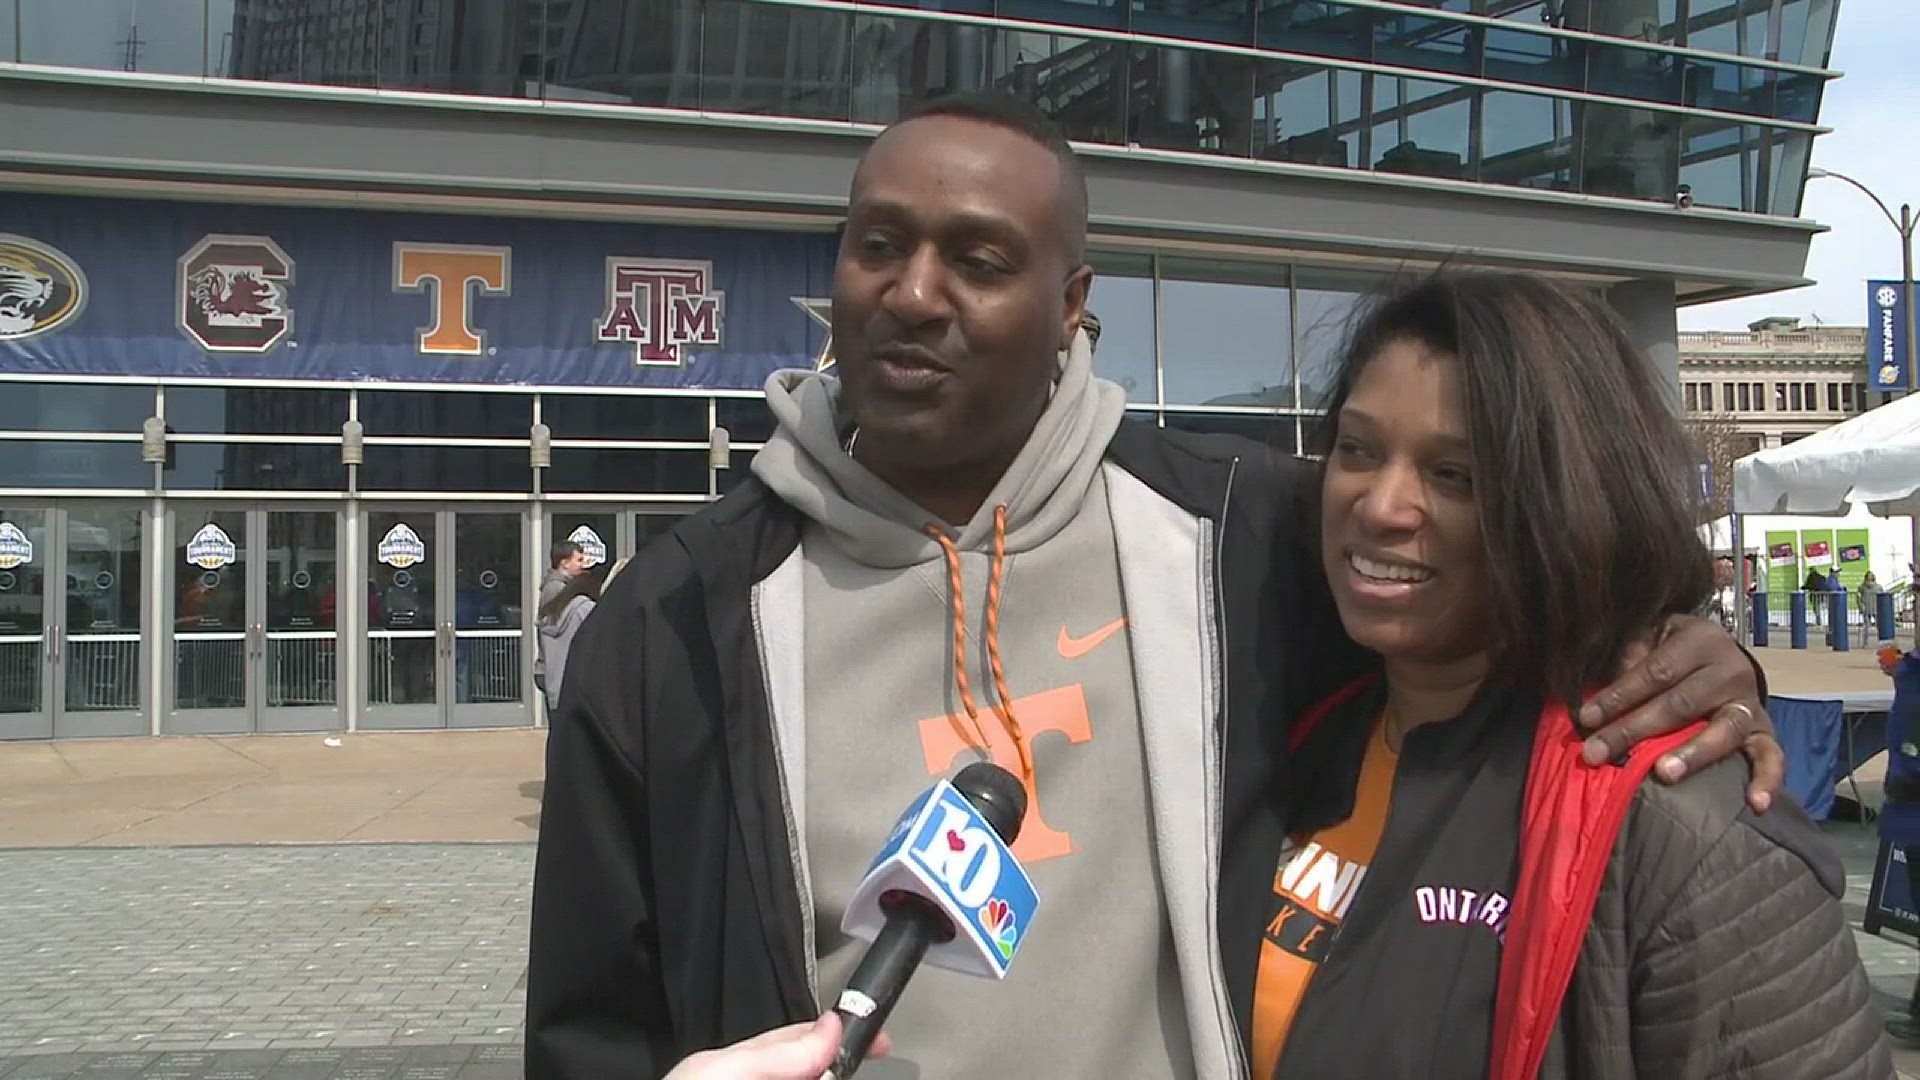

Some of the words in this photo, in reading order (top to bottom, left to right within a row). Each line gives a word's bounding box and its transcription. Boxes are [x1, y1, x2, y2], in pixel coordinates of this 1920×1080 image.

[394, 243, 511, 355] T
[1882, 309, 1894, 361] FANFARE
[1416, 886, 1507, 932] ONTR
